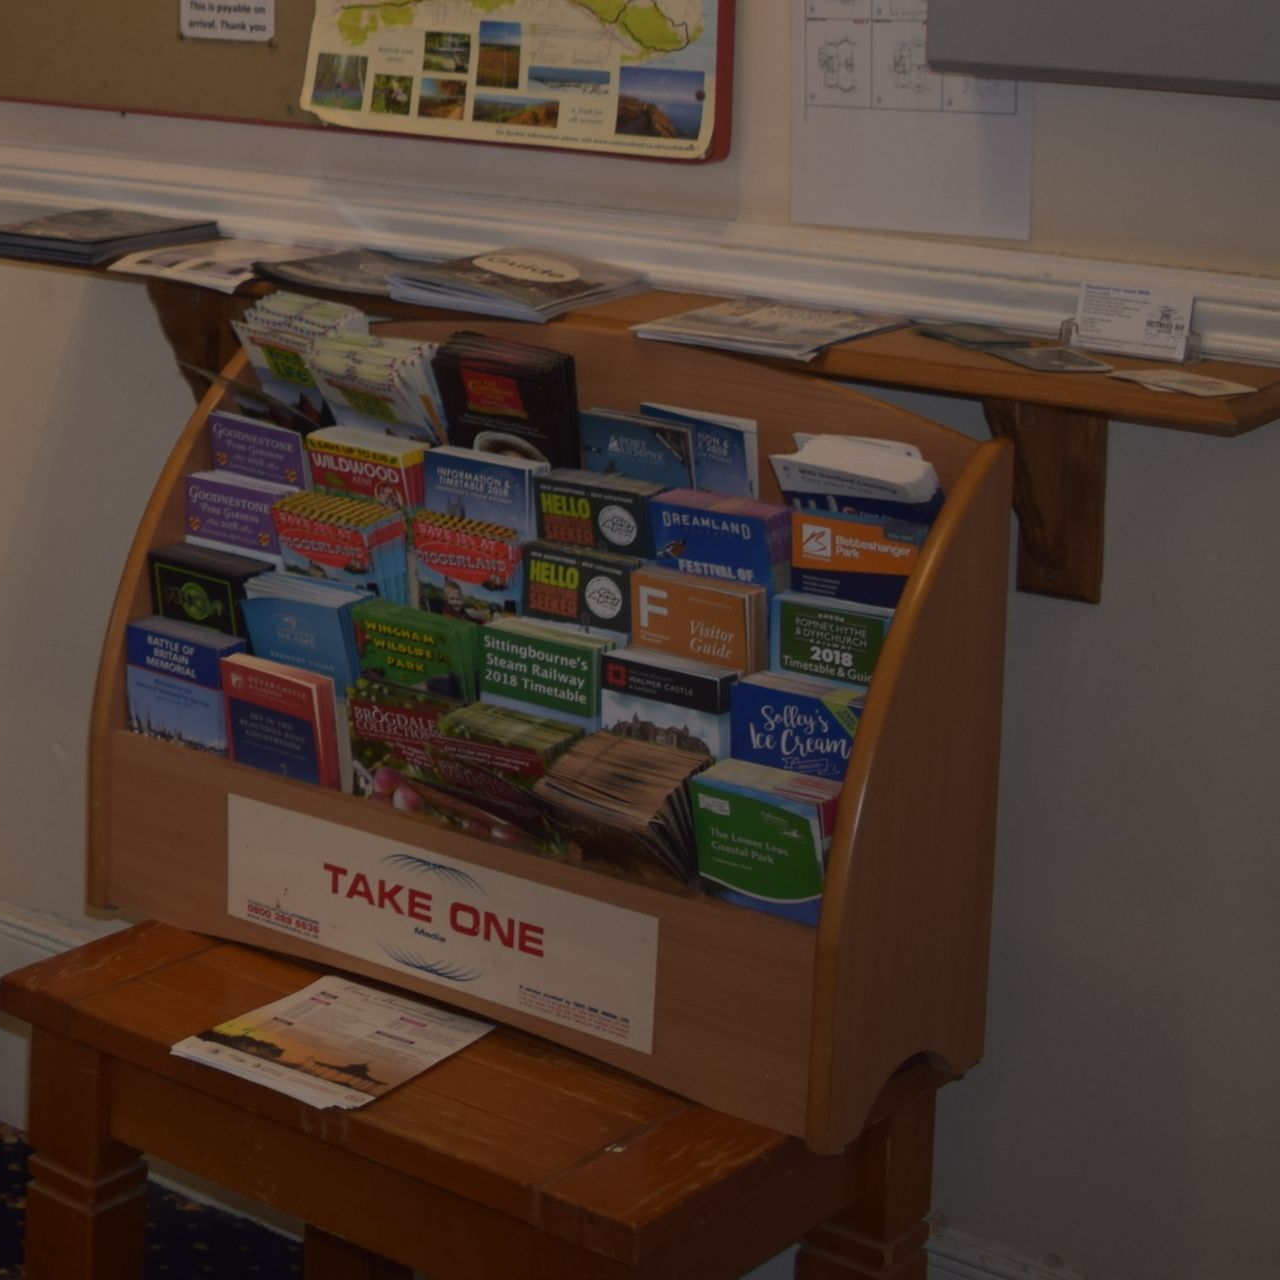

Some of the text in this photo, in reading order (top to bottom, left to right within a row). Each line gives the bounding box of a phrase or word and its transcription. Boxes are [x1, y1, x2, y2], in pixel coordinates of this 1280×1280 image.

[190, 0, 266, 15] This is payable on
[188, 20, 267, 33] arrival. Thank you
[211, 421, 295, 453] GOODNESTONE
[317, 440, 370, 459] SAVE UP TO
[311, 452, 400, 484] WILDWOOD
[436, 466, 512, 490] INFORMATION &
[188, 484, 271, 514] GOODNESTONE
[439, 476, 485, 494] TIMETABLE
[487, 484, 510, 498] 2018
[541, 492, 592, 519] HELLO
[280, 511, 353, 539] SAVE AT
[544, 524, 596, 546] SEEKER
[661, 510, 752, 540] DREAMLAND
[284, 535, 365, 560] DIGGERLAND
[418, 524, 497, 551] SAVE AT
[416, 550, 506, 573] DIGGERLAND
[835, 546, 861, 561] Park
[530, 559, 579, 590] HELLO
[678, 558, 754, 581] FESTIVAL OF
[529, 593, 578, 618] SEEKER
[639, 585, 670, 629] F
[363, 620, 435, 646] WINGHAM
[689, 619, 735, 642] Visitor
[802, 627, 868, 649] DYMCHURCH
[837, 626, 868, 640] HYTHE
[146, 634, 196, 656] BATTLE OF
[152, 645, 189, 666] BRITAIN
[374, 637, 434, 661] WILDLIFE
[483, 634, 589, 672] Sittingbourne's
[689, 638, 732, 660] Guide
[810, 646, 853, 668] 2018
[145, 656, 198, 680] MEMORIAL
[386, 654, 426, 674] PARK
[485, 652, 586, 690] Steam Railway
[781, 655, 846, 679] Timetable &
[484, 668, 587, 706] 2018 Timetable
[629, 676, 695, 698] WALMER CASTLE
[353, 704, 437, 732] BROGDALE
[760, 703, 829, 736] Solley's
[749, 721, 853, 761] Ice Cream
[708, 826, 789, 858] The Lower Leas
[710, 840, 776, 866] Coastal Park
[247, 903, 272, 919] 0800
[323, 862, 545, 958] TAKE ONE
[413, 925, 447, 944] Media
